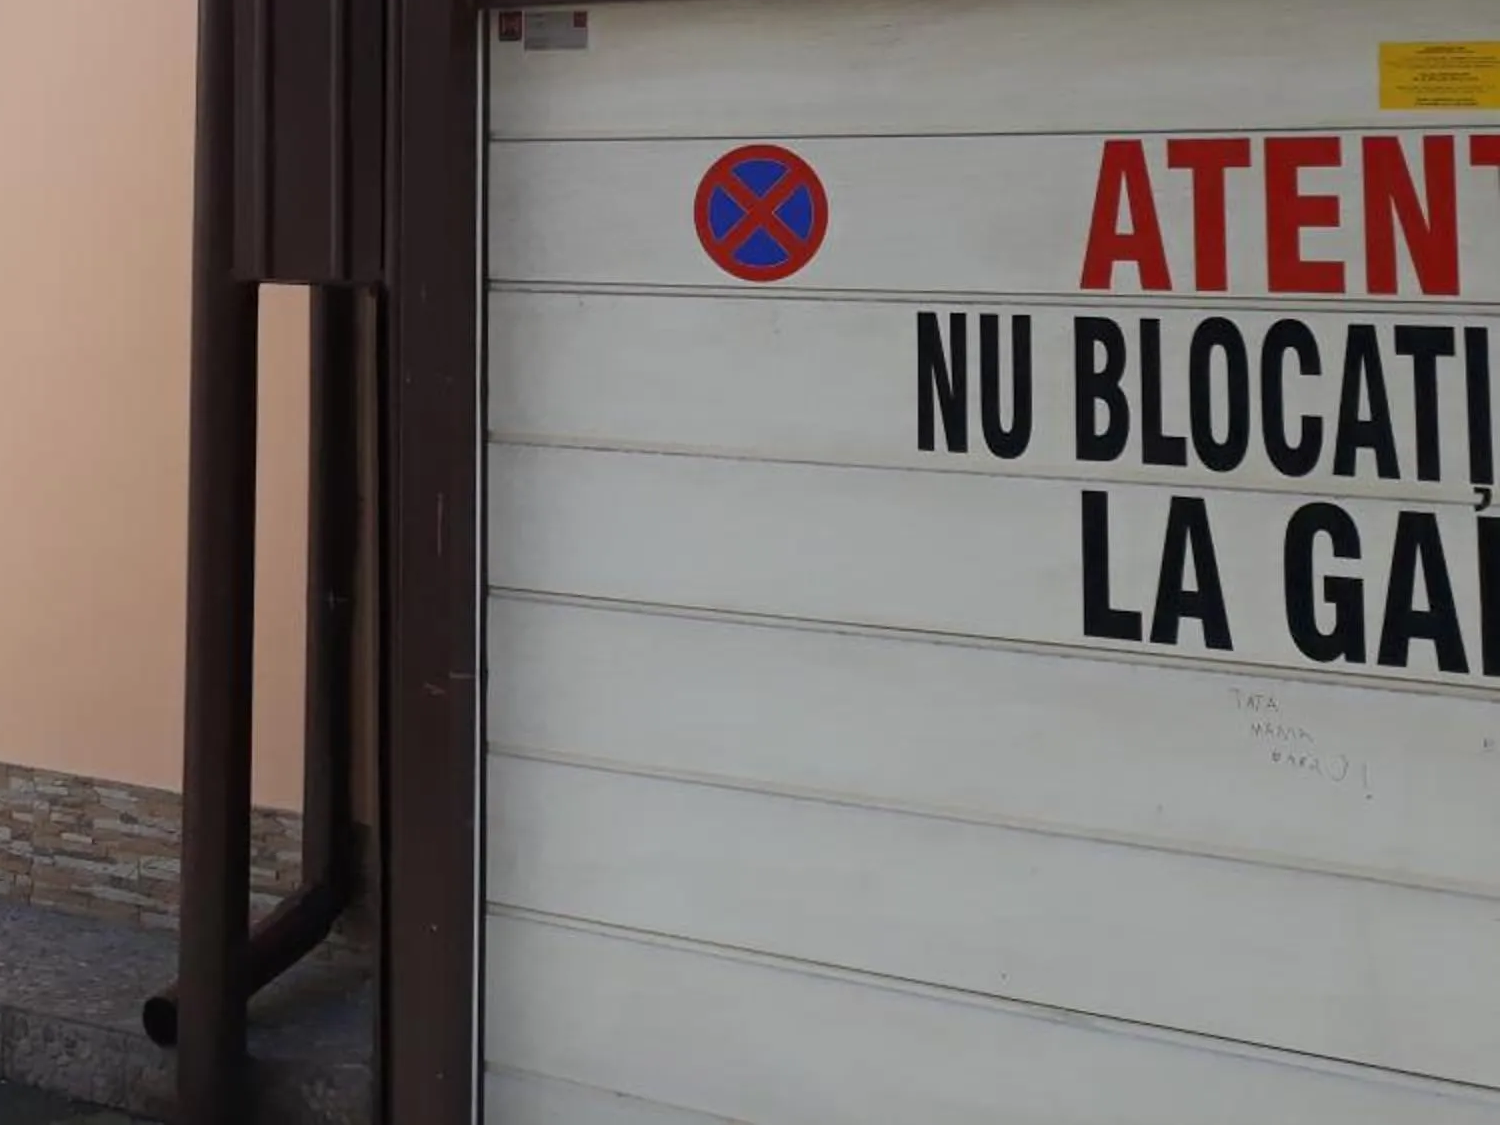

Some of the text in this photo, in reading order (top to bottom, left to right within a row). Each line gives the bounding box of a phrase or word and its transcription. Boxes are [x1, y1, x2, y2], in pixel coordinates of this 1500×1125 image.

[917, 311, 1032, 459] NU
[1081, 490, 1500, 677] LA GA
